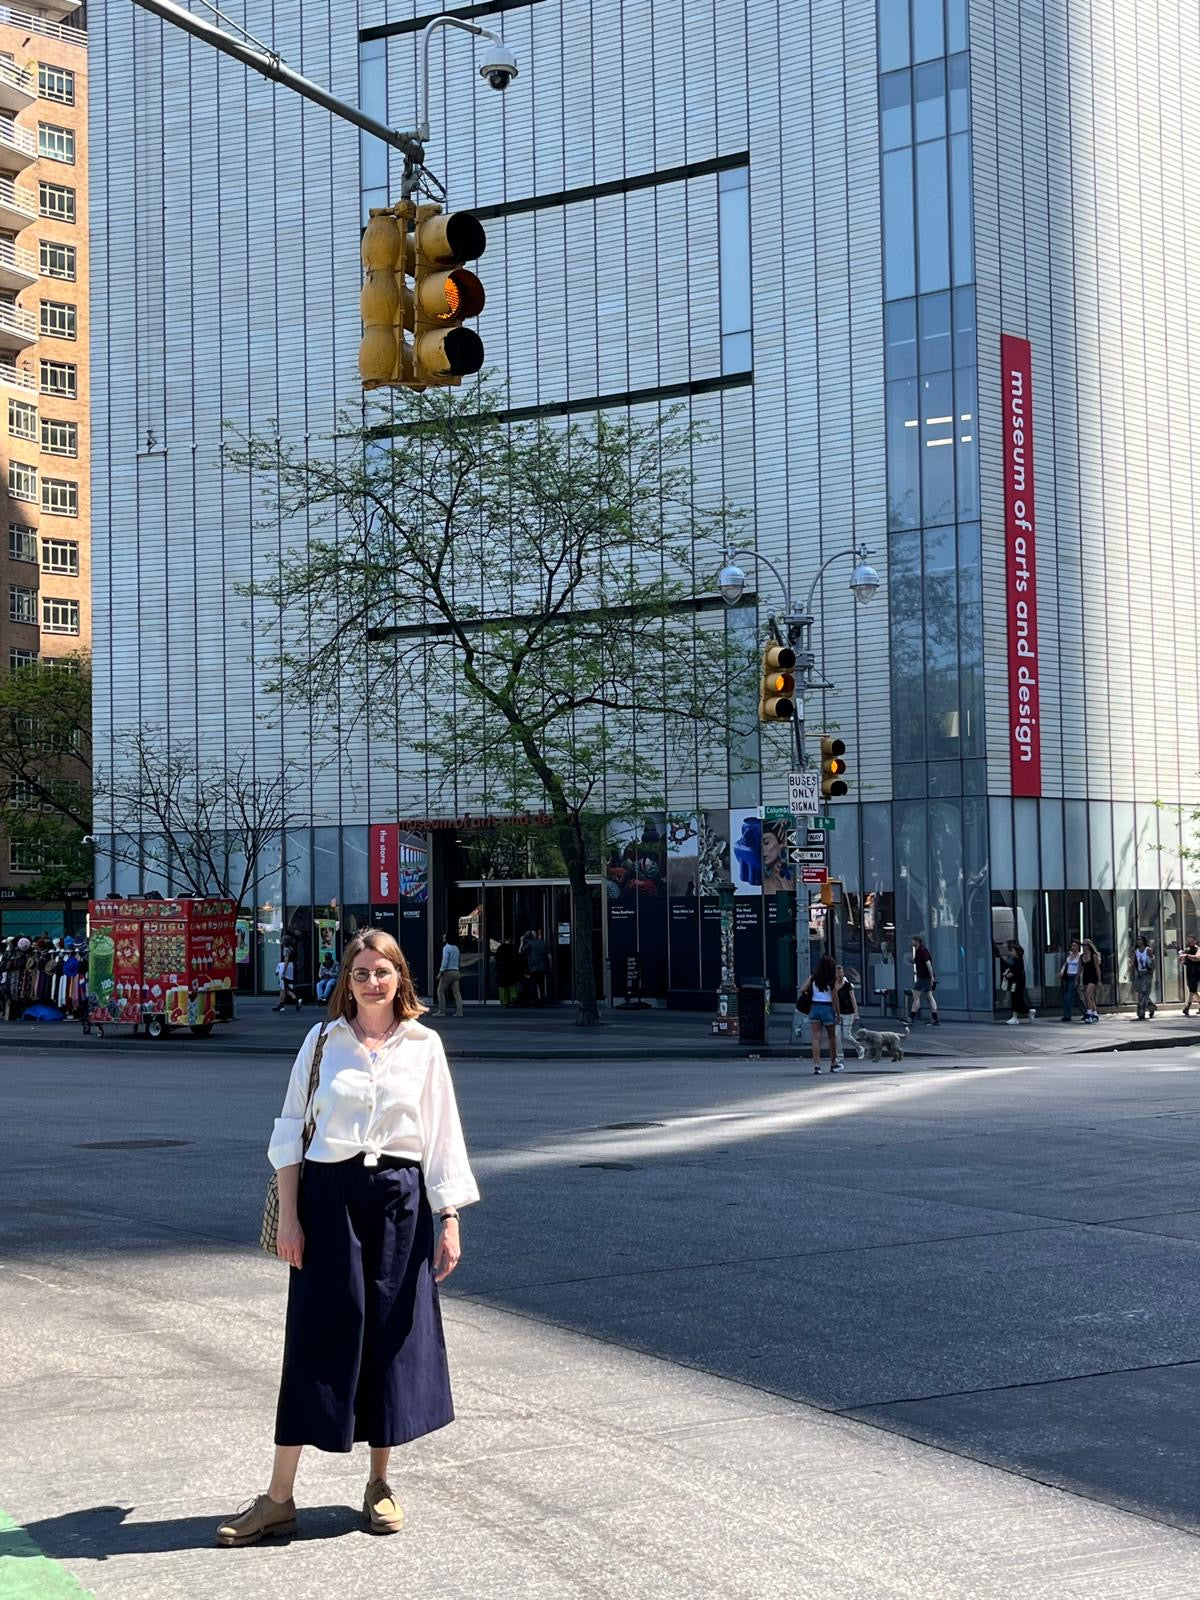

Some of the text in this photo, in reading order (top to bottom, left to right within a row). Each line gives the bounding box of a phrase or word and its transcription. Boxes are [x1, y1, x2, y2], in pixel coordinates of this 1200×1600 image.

[1011, 370, 1036, 762] museum of arts and design
[789, 776, 817, 786] BUSES
[792, 787, 815, 798] ONLY
[791, 801, 817, 812] SIGNAL
[379, 830, 388, 842] the
